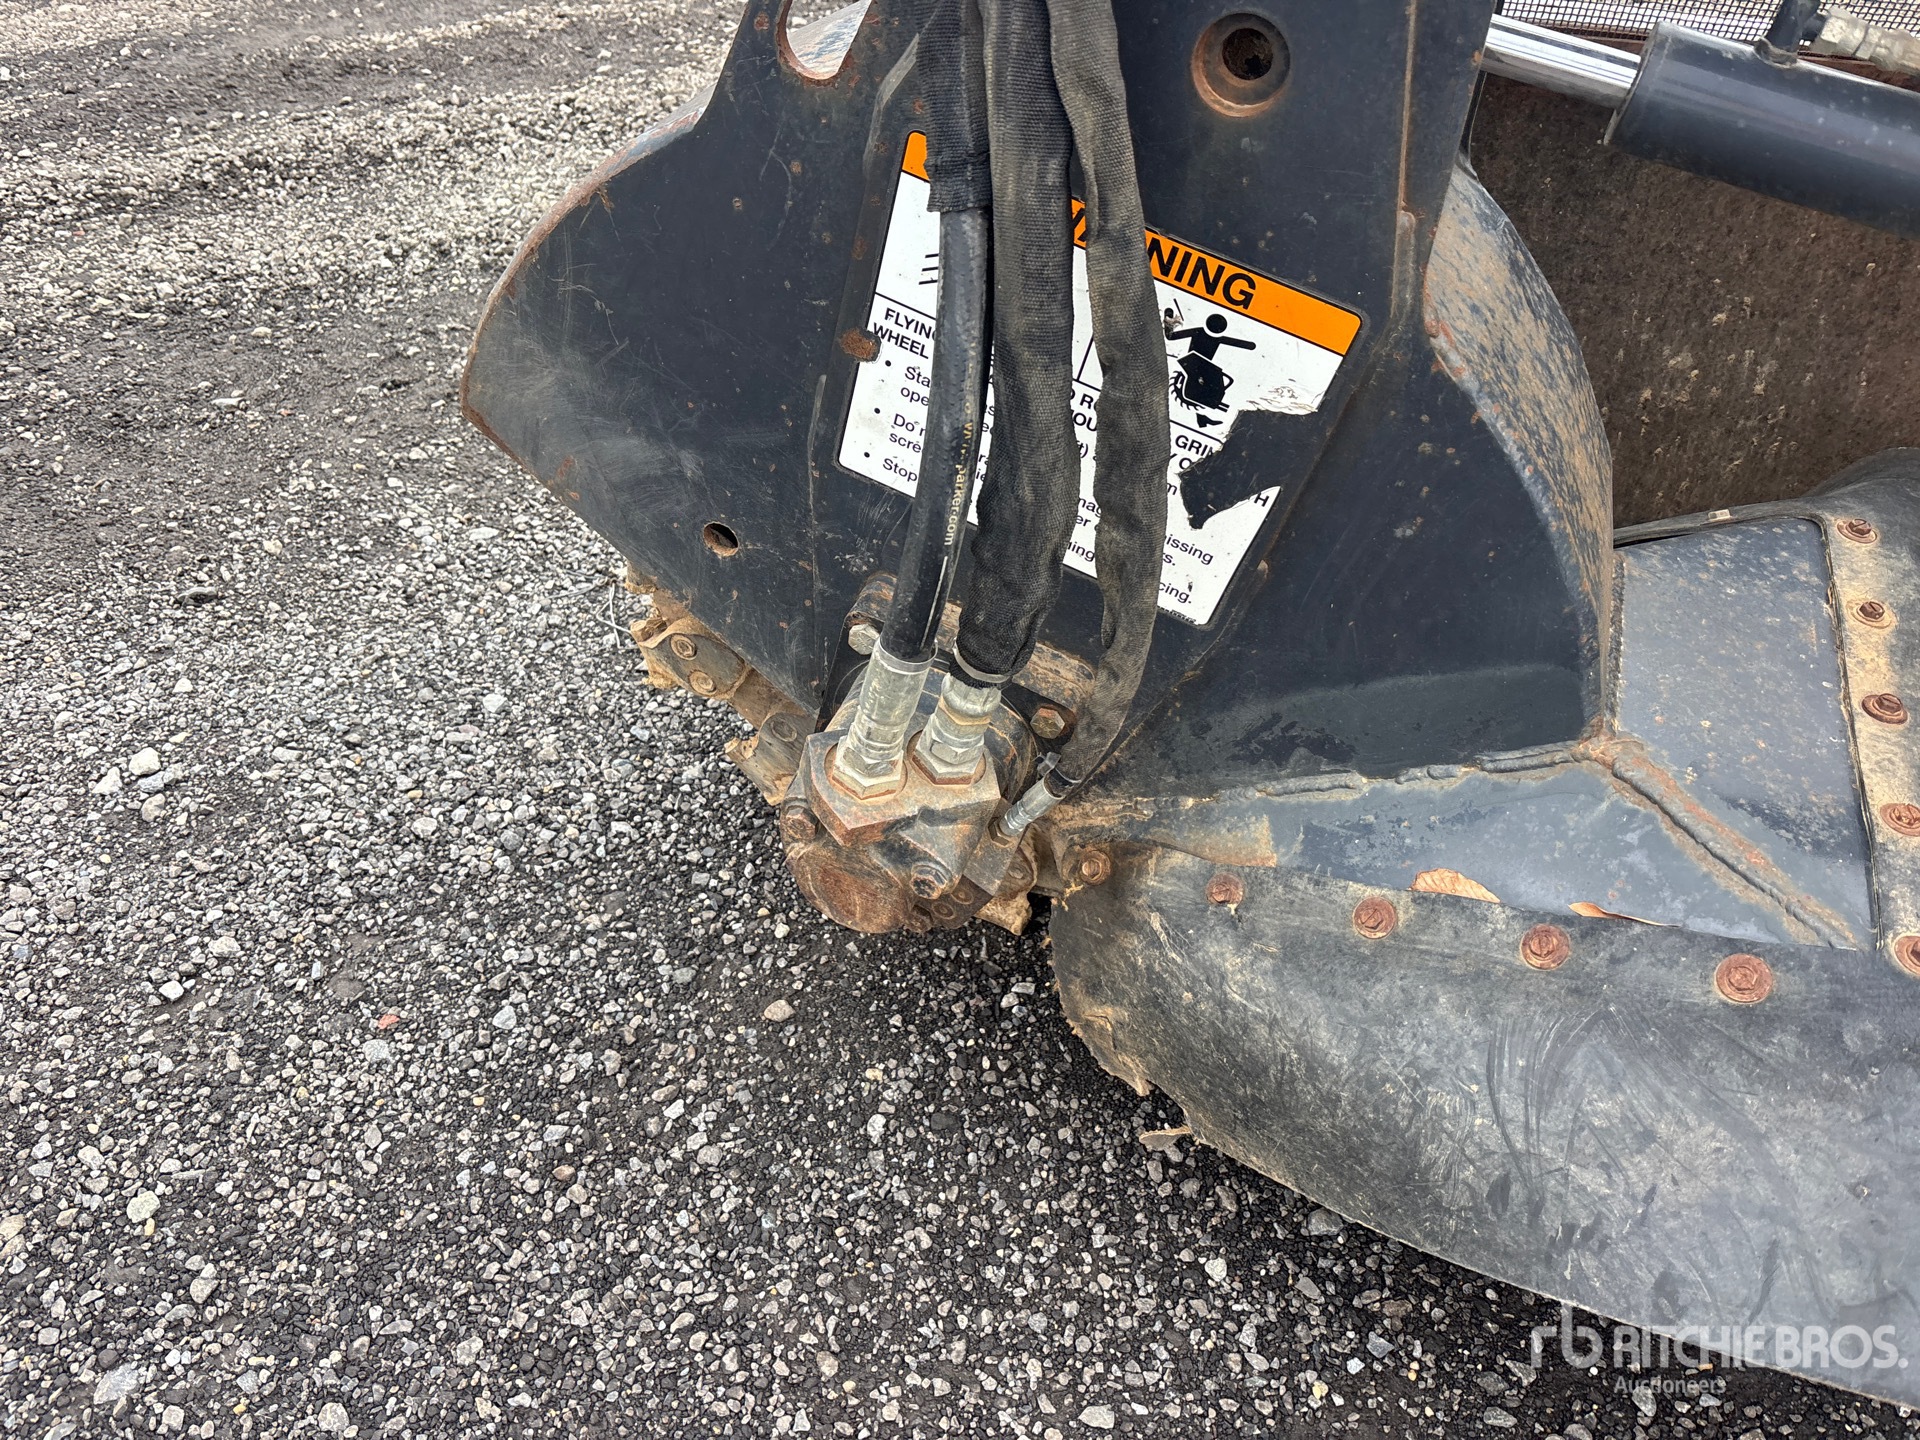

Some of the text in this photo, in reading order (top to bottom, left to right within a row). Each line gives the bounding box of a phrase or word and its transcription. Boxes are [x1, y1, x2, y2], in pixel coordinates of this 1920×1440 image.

[873, 322, 930, 360] WHEEL
[893, 413, 915, 432] Do
[883, 458, 918, 482] Stop
[1164, 533, 1214, 565] issing
[1159, 582, 1192, 604] cing.
